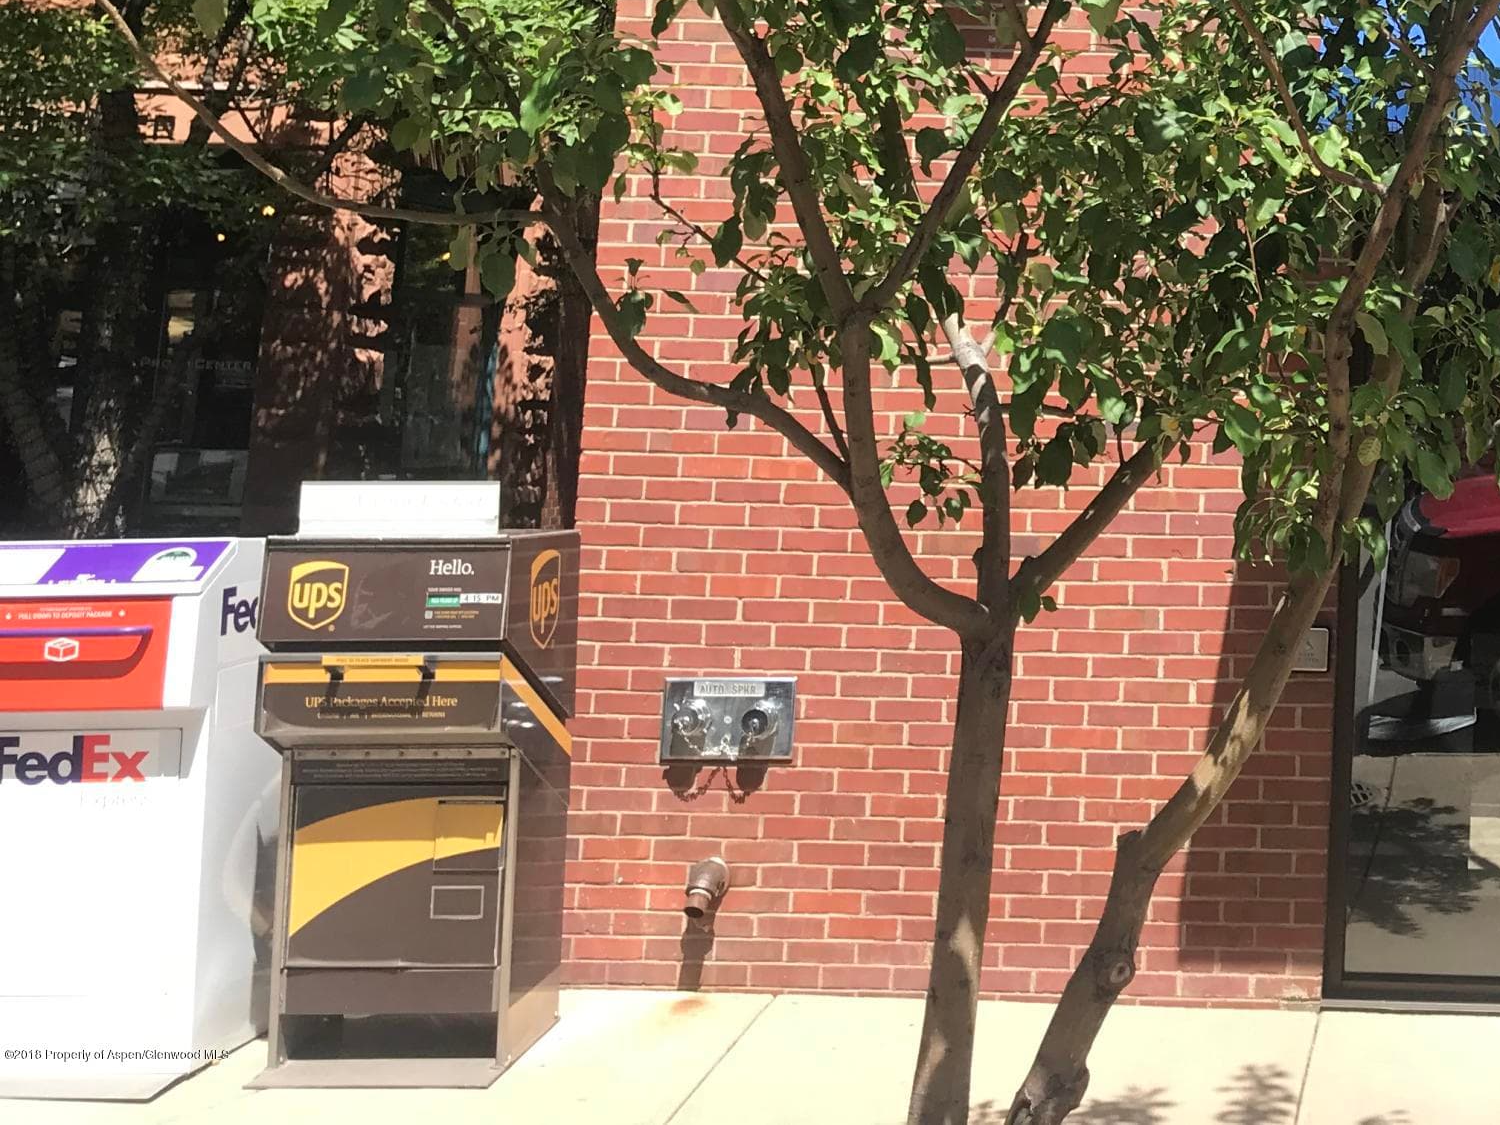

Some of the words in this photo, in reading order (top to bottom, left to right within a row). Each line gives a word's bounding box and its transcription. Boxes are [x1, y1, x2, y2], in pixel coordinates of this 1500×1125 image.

[429, 558, 475, 576] Hello.
[486, 594, 500, 602] PM
[699, 683, 725, 695] AUTO
[305, 696, 327, 708] UPS
[330, 695, 378, 709] Packages
[379, 694, 429, 709] Accepted
[432, 695, 458, 708] Here
[0, 733, 150, 786] FedEx
